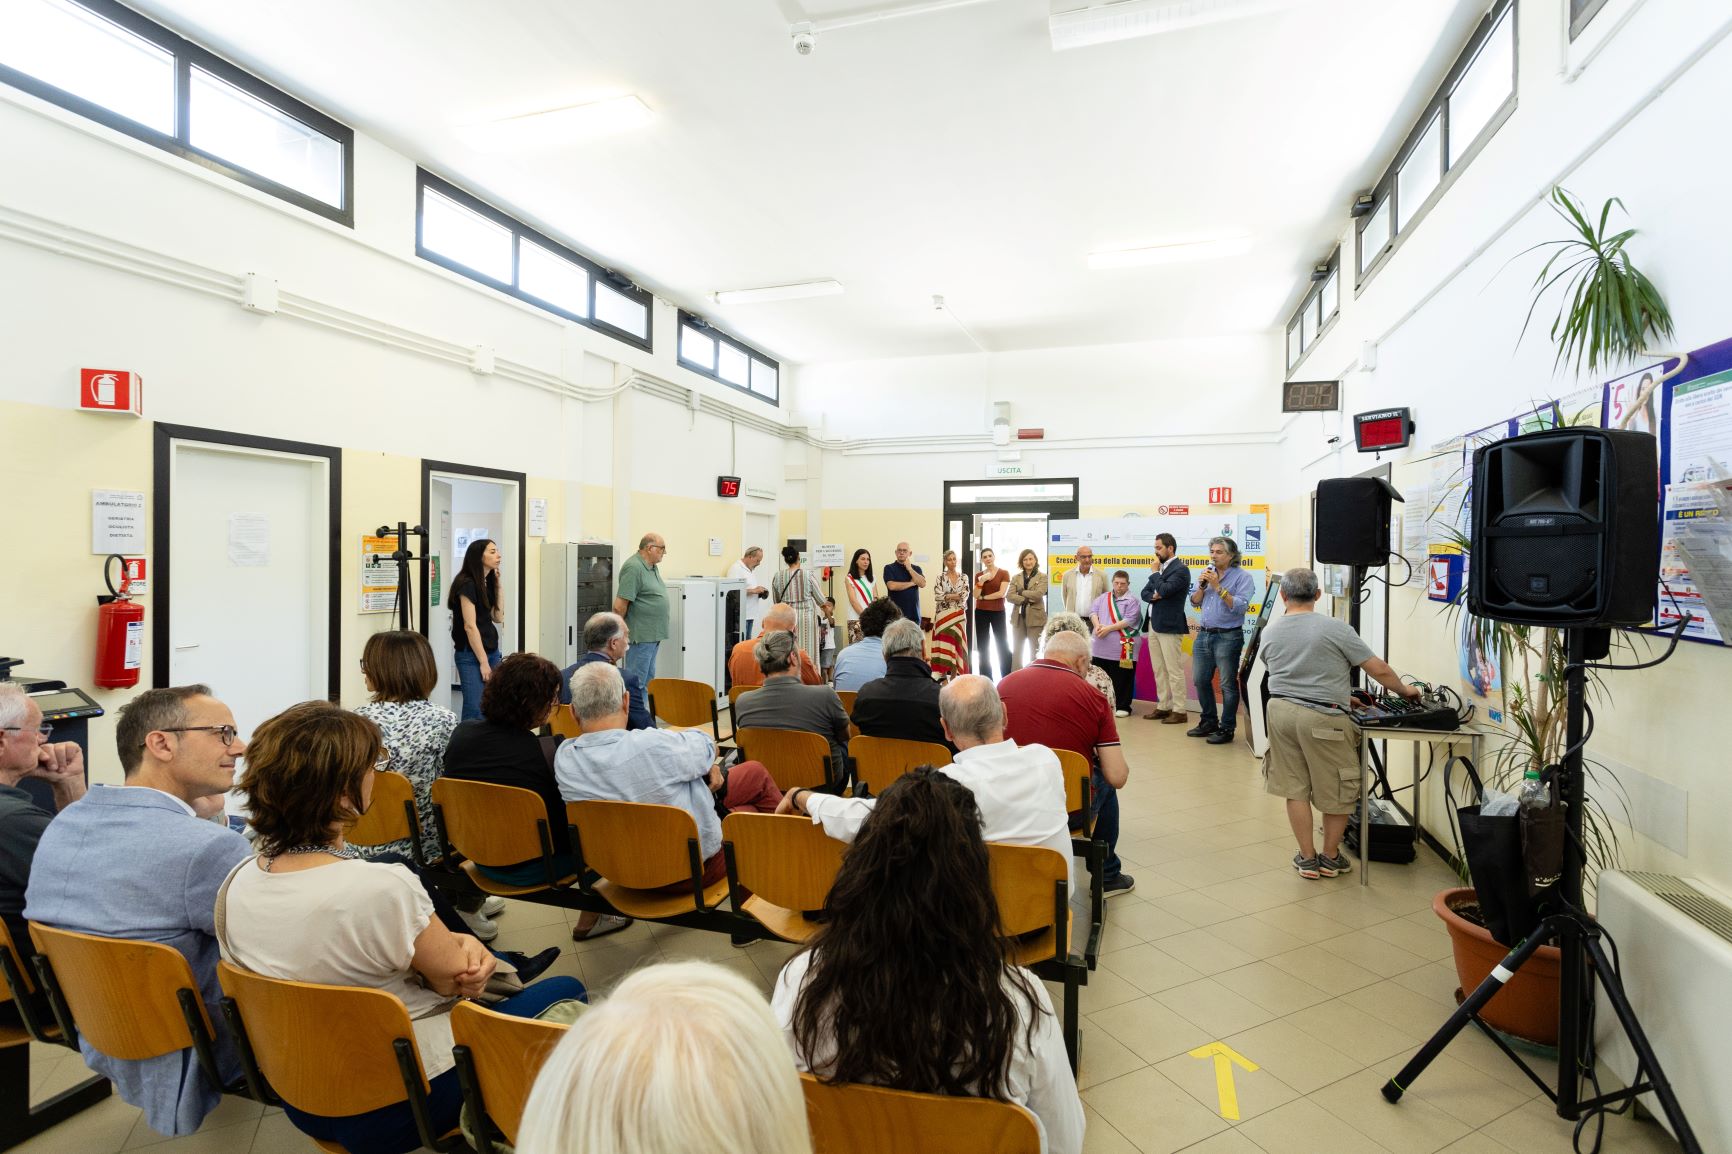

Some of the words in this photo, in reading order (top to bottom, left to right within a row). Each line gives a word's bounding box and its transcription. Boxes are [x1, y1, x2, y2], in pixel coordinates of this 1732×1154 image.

[1361, 412, 1391, 421] SERVIAMO
[724, 481, 737, 495] 75
[1245, 541, 1260, 549] RER
[1103, 556, 1120, 565] della
